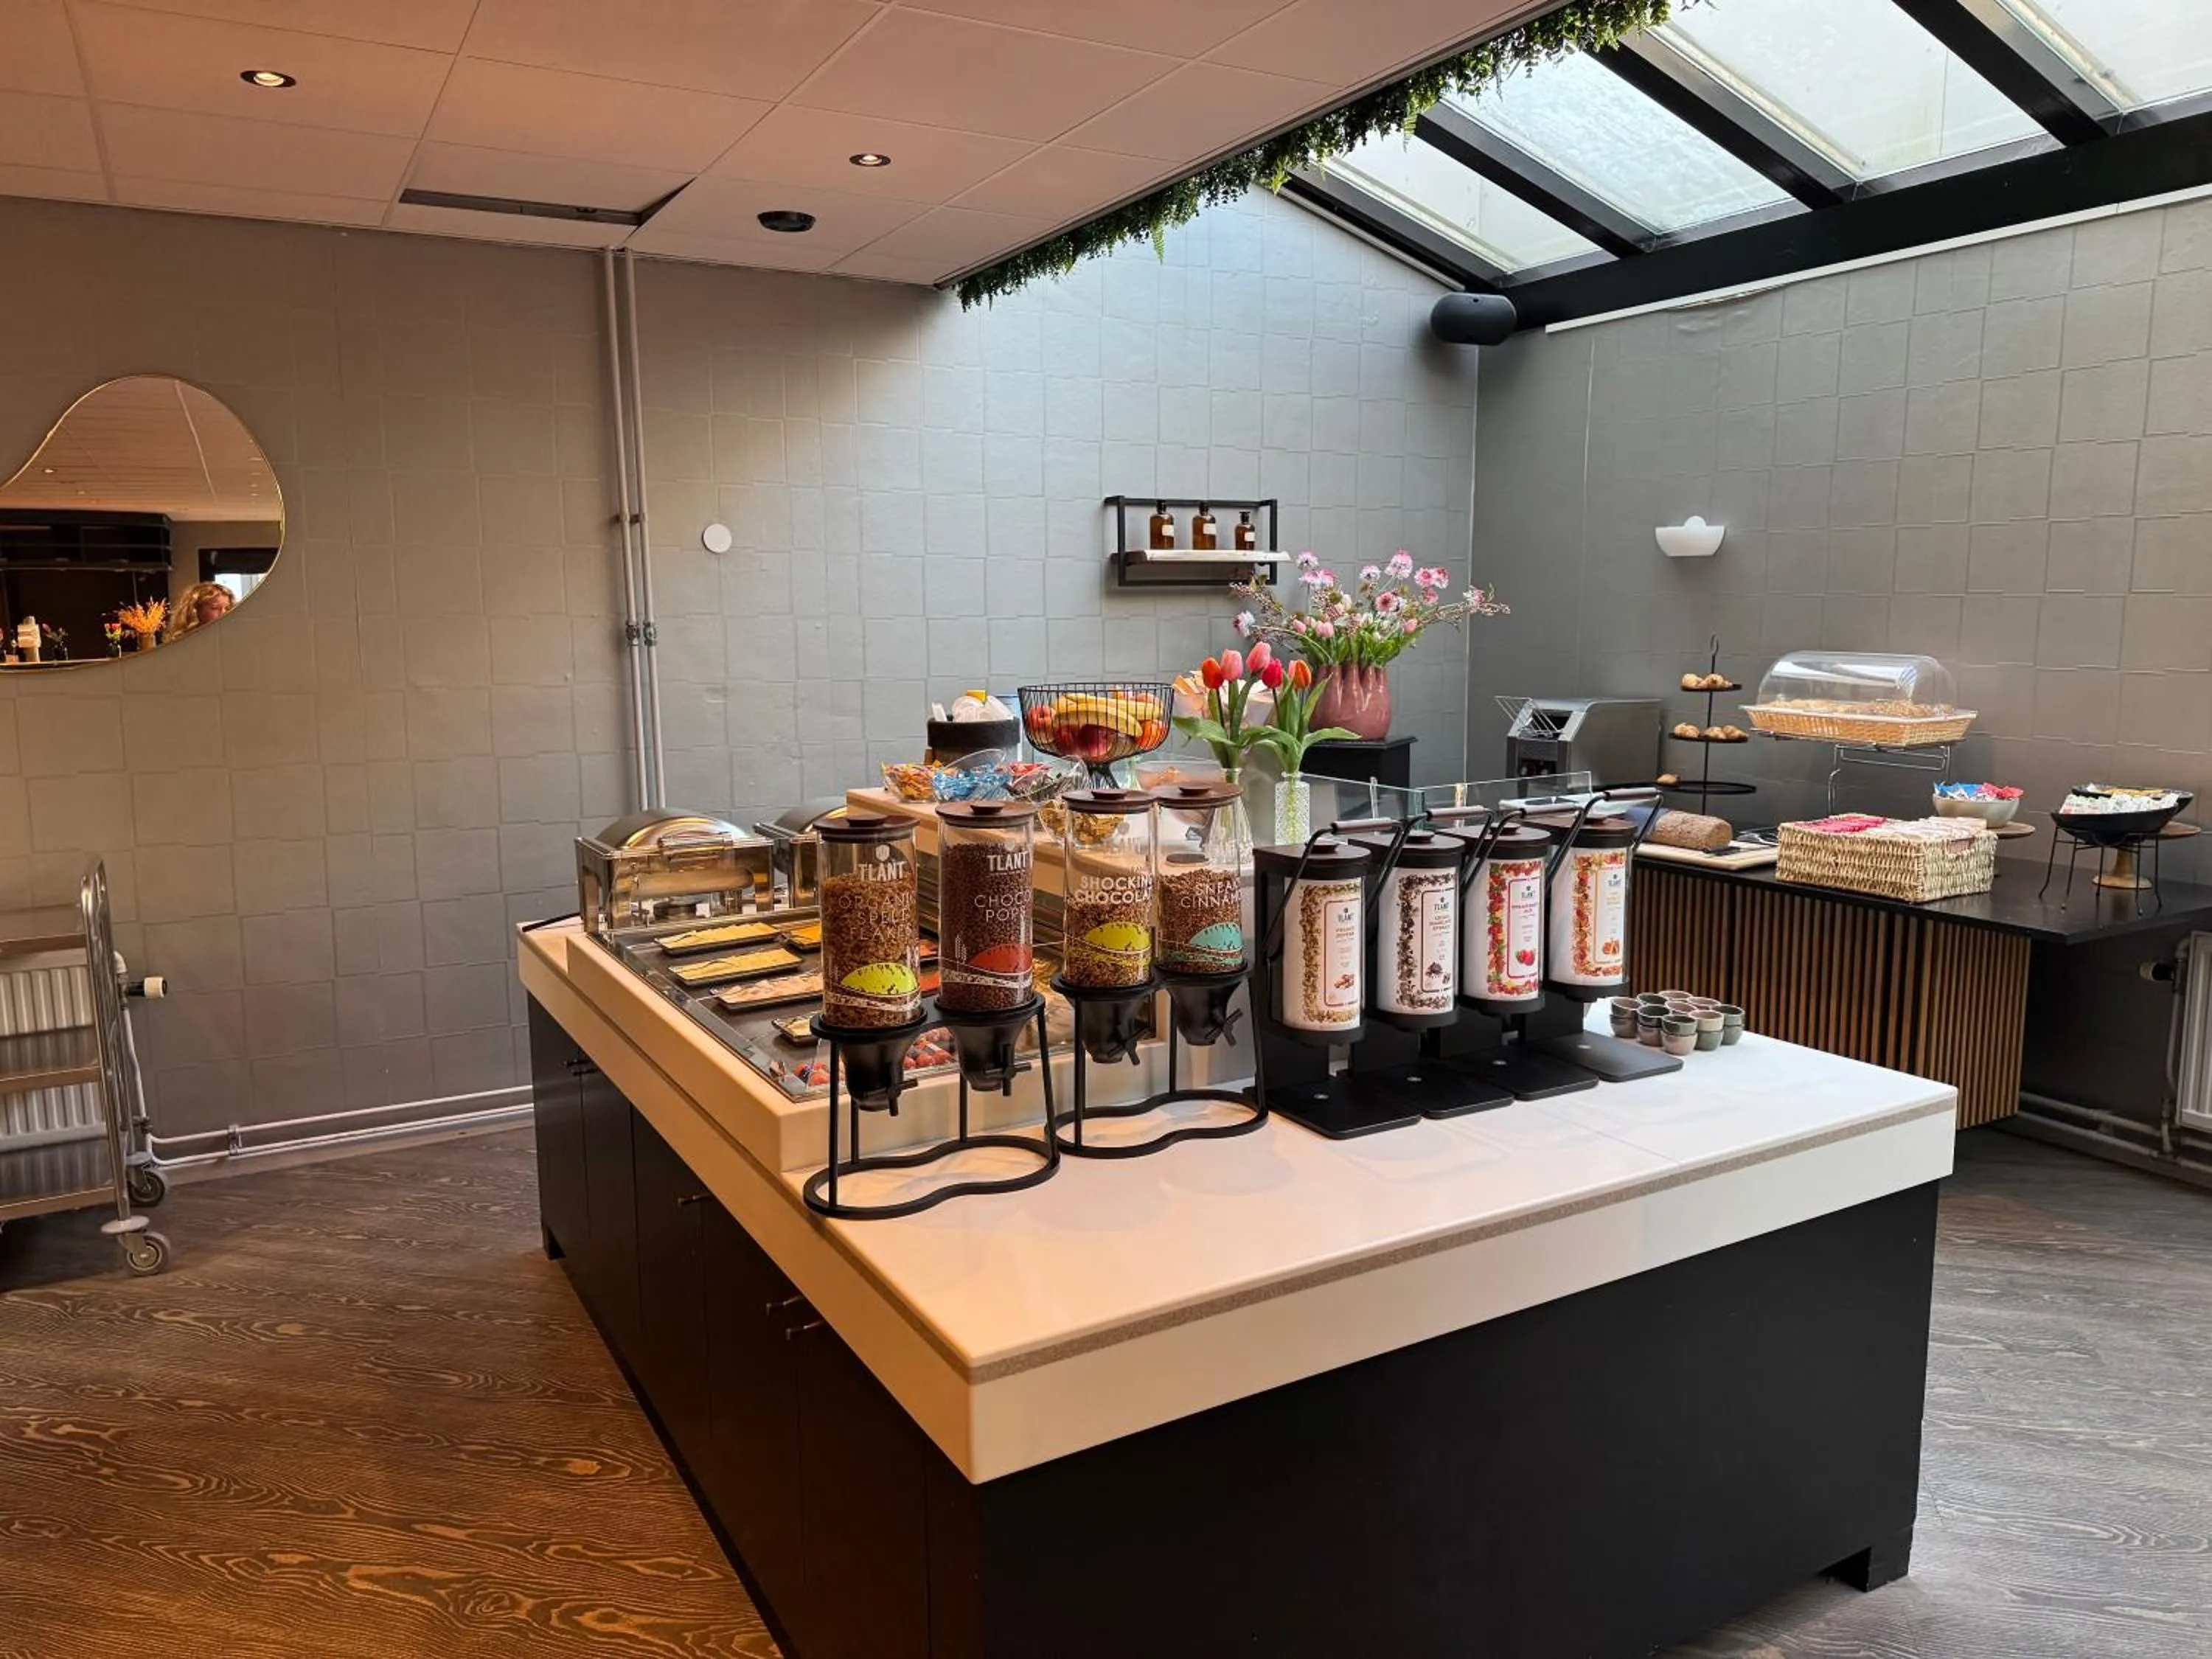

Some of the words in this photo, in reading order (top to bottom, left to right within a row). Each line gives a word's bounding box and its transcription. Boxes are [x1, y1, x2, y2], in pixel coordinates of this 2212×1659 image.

[858, 861, 906, 881] TLANT
[987, 852, 1028, 872] TLANT
[974, 890, 1031, 908] CHOCO
[986, 905, 1026, 922] POPS
